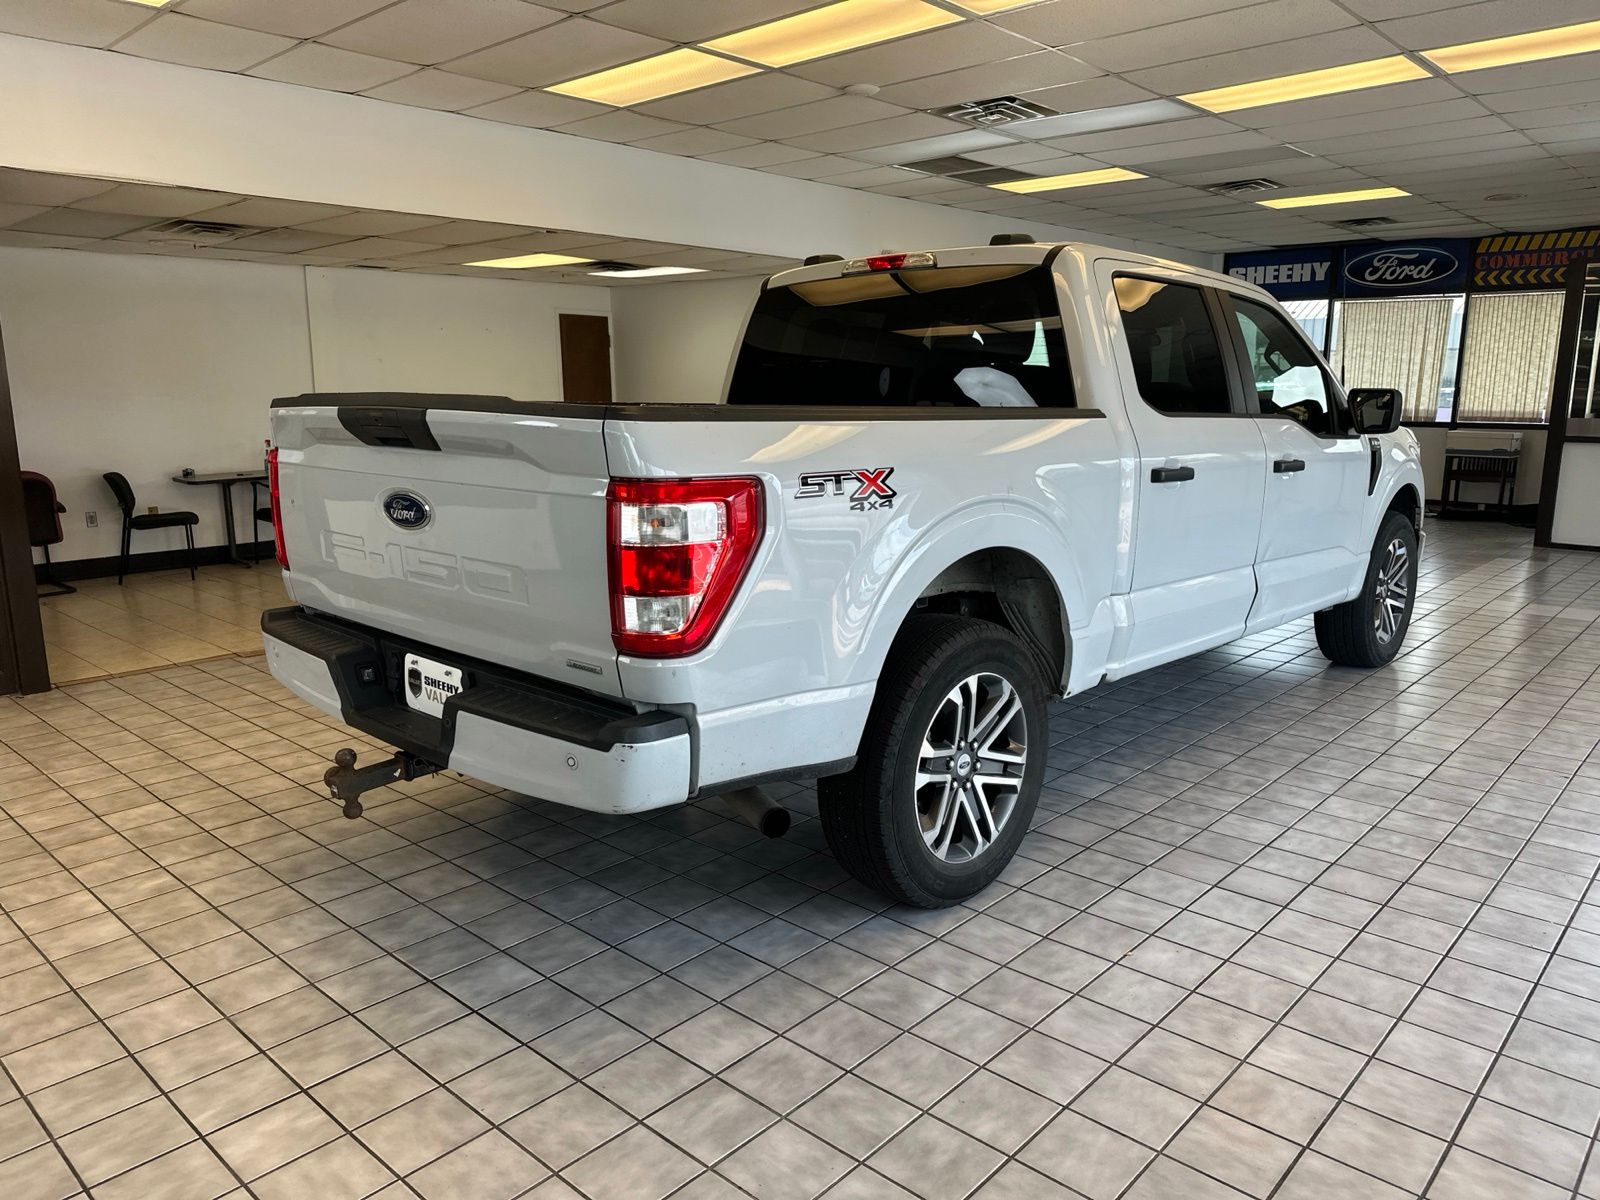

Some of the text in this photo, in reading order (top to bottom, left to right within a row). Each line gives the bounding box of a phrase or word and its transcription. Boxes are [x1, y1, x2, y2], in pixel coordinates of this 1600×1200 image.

[1229, 261, 1331, 284] SHEEHY
[1364, 253, 1437, 281] Ford
[794, 467, 897, 502] STX
[390, 498, 417, 522] Ford
[320, 529, 530, 607] F-150
[424, 675, 459, 695] SHEEHY
[424, 686, 448, 705] VAL
